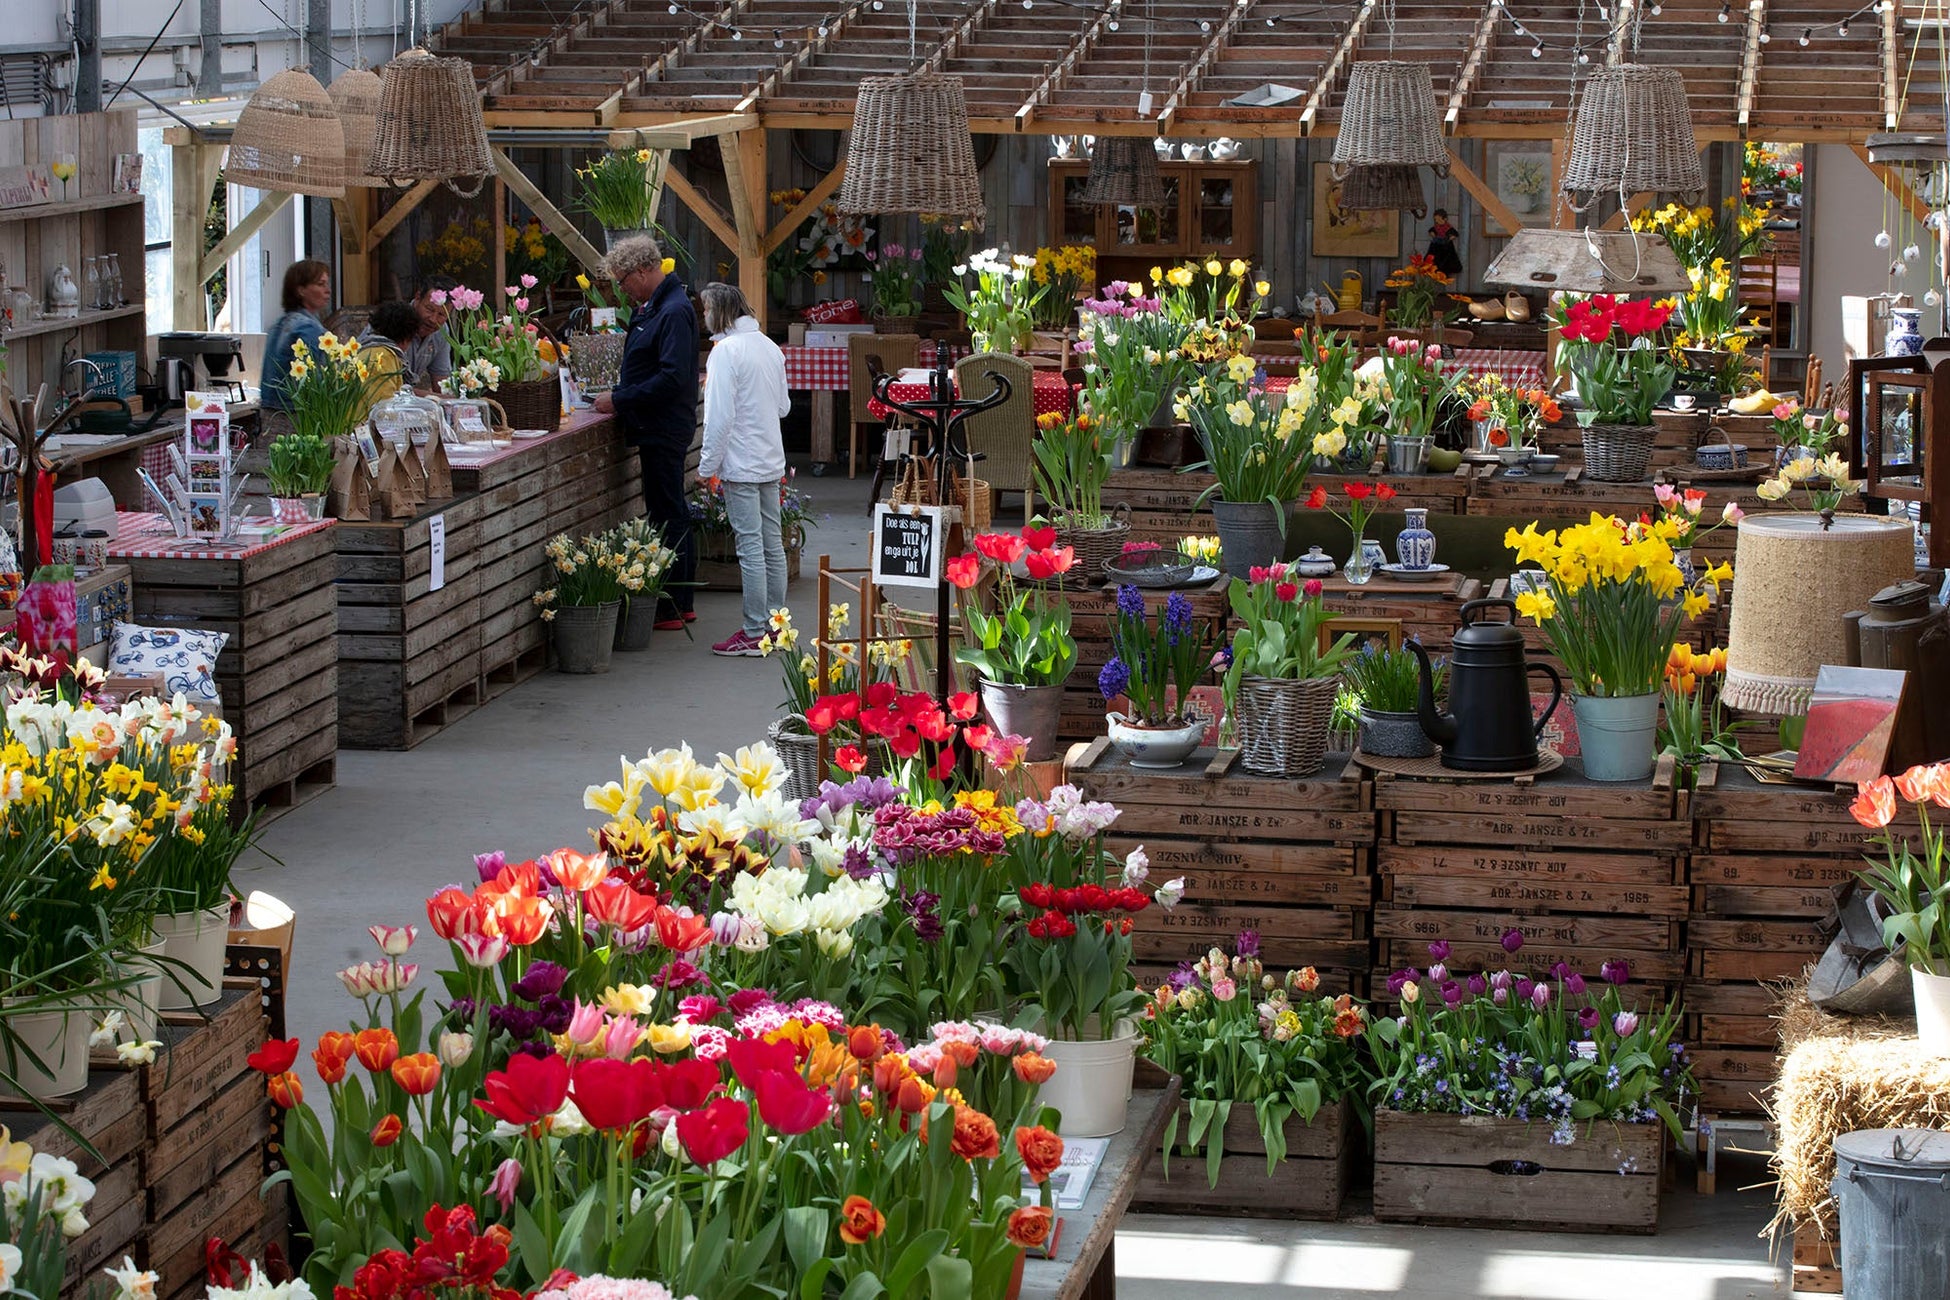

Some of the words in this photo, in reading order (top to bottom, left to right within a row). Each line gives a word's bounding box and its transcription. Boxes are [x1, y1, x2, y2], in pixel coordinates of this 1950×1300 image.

[886, 517, 898, 529] Doe
[899, 518, 908, 529] als
[1207, 815, 1248, 828] JANSZE
[1253, 817, 1261, 828] &
[1523, 824, 1563, 836] JANSZE
[1568, 826, 1576, 837] &
[1490, 859, 1497, 870] &
[1501, 859, 1541, 872] JANSZE
[1184, 879, 1198, 890] DR.
[1206, 879, 1244, 891] JANSZE
[1250, 880, 1259, 891] &
[1518, 888, 1560, 900] JANSZE
[1566, 889, 1574, 900] &
[1623, 892, 1650, 903] 1965
[1190, 915, 1231, 928] JANSZE
[1513, 952, 1553, 964] JANSZE
